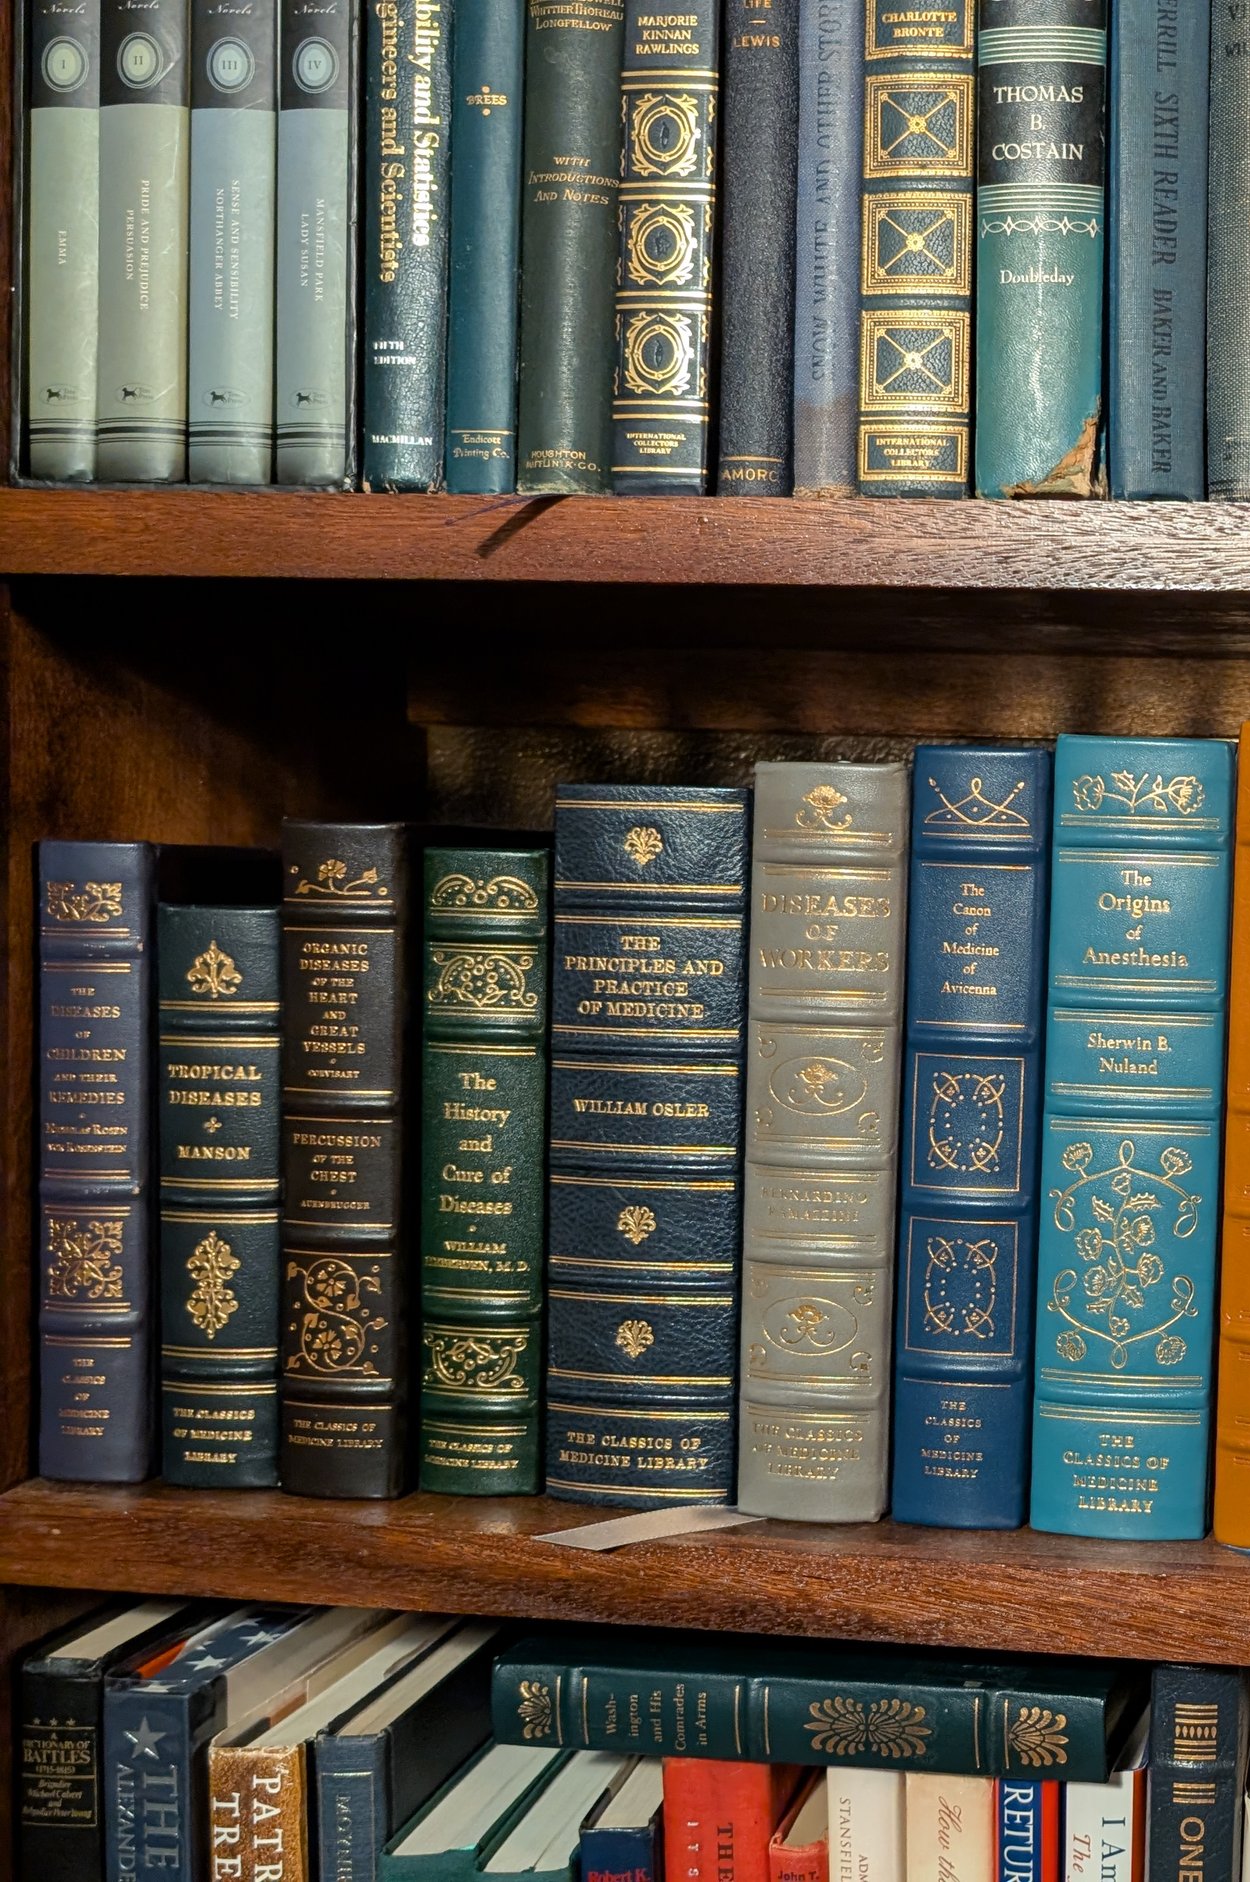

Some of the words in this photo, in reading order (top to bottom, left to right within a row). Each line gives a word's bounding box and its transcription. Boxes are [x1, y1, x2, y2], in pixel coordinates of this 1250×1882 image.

[638, 15, 698, 27] MARJORIE
[882, 11, 957, 23] CHARLOTTE
[642, 29, 692, 40] KINNAN
[733, 36, 781, 49] LEWIS
[636, 43, 699, 55] RAWLINGS
[414, 75, 440, 124] and
[993, 86, 1084, 104] THOMAS
[381, 108, 405, 156] and
[1153, 91, 1179, 160] SIXTH
[992, 143, 1084, 160] COSTAIN
[141, 180, 150, 215] PRIDE
[231, 180, 240, 215] SENSE
[413, 131, 440, 246] Statistics
[380, 163, 405, 283] Scientists
[1151, 170, 1179, 266] READER
[141, 219, 150, 243] AND
[231, 220, 240, 244] AND
[301, 213, 309, 244] LADY
[315, 199, 325, 268] MANSFIELD
[58, 230, 67, 265] EMMA
[301, 250, 309, 287] SUSAN
[1000, 267, 1075, 287] Doubleday
[139, 249, 150, 310] PREJUDICE
[230, 248, 239, 319] SENSIBILITY
[314, 273, 324, 301] PARK
[1152, 287, 1173, 357] BAKER
[1151, 362, 1168, 404] AND
[1151, 406, 1172, 474] BAKER
[721, 468, 778, 482] AMORC
[1121, 869, 1152, 886] The
[960, 883, 985, 897] The
[761, 893, 892, 918] DISEASES
[952, 903, 992, 917] Canon
[1098, 892, 1171, 918] Origins
[805, 925, 839, 941] OF
[1125, 927, 1143, 941] of
[620, 936, 661, 951] THE
[942, 942, 1000, 957] Medicine
[299, 959, 370, 972] DISEASES
[564, 955, 677, 975] PRINCIPLES
[681, 960, 724, 976] AND
[759, 949, 890, 973] WORKERS
[1082, 946, 1189, 968] Anesthesia
[309, 992, 358, 1005] HEART
[593, 980, 688, 997] PRACTICE
[941, 981, 997, 996] Avicenna
[577, 1000, 603, 1015] OF
[607, 1002, 705, 1019] MEDICINE
[1087, 1033, 1152, 1051] Sherwin
[1157, 1036, 1172, 1051] B.
[167, 1063, 263, 1081] TROPICAL
[1099, 1057, 1159, 1075] Nuland
[458, 1073, 497, 1091] The
[169, 1091, 262, 1107] DISEASES
[574, 1098, 647, 1116] WILLIAM
[652, 1103, 710, 1118] OSLER
[442, 1102, 511, 1128] History
[293, 1133, 382, 1148] PERCUSSION
[459, 1134, 493, 1152] and
[177, 1145, 252, 1160] MANSON
[310, 1170, 358, 1183] CHEST
[442, 1164, 484, 1184] Cure
[491, 1166, 513, 1184] of
[439, 1194, 513, 1215] Diseases
[567, 1431, 596, 1445] THE
[601, 1434, 673, 1450] CLASSICS
[680, 1437, 701, 1450] OF
[1098, 1434, 1135, 1448] THE
[559, 1449, 631, 1468] MEDICINE
[637, 1455, 709, 1471] LIBRARY
[1063, 1451, 1140, 1469] CLASSICS
[1146, 1456, 1170, 1470] OF
[1073, 1474, 1159, 1492] MEDICINE
[1077, 1496, 1154, 1513] LIBRARY
[650, 1689, 662, 1714] His
[695, 1691, 707, 1726] Arms
[605, 1692, 618, 1736] Wash-
[629, 1693, 641, 1738] ington
[674, 1683, 686, 1751] Comrades
[650, 1718, 663, 1743] and
[696, 1729, 707, 1747] in
[24, 1749, 91, 1764] BATTLES
[143, 1764, 180, 1868] THE
[938, 1796, 962, 1850] How
[1072, 1834, 1091, 1873] The
